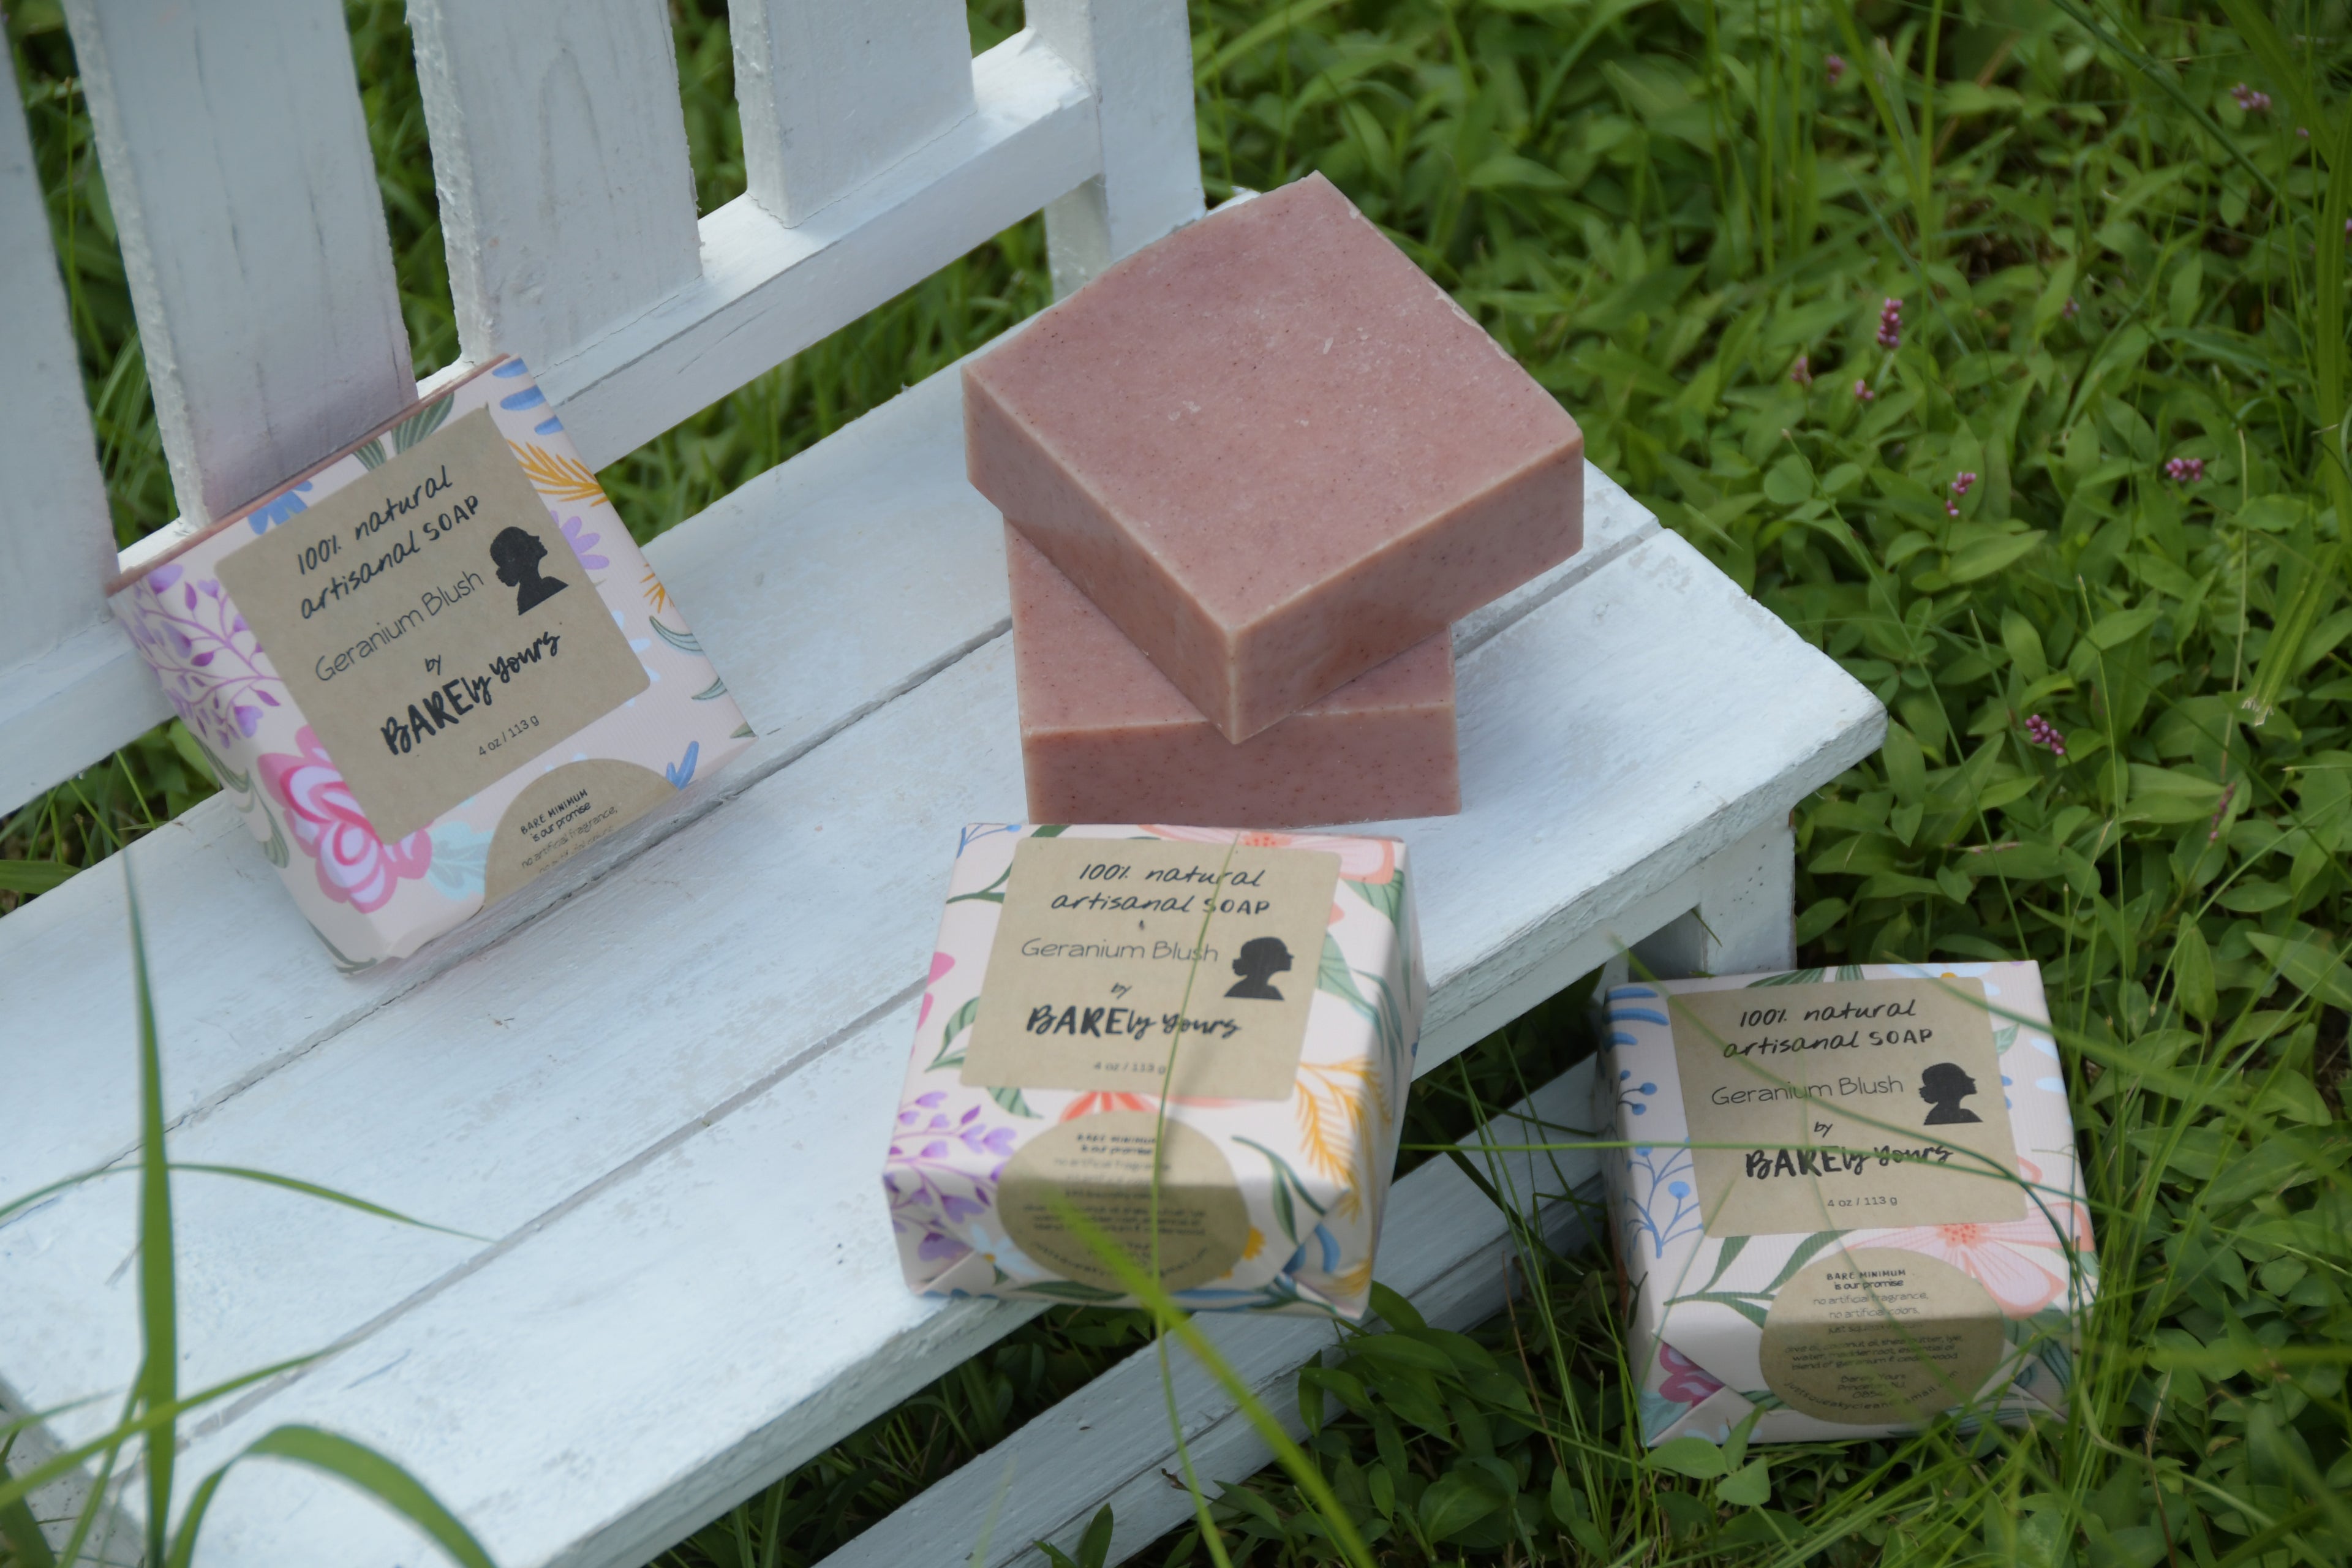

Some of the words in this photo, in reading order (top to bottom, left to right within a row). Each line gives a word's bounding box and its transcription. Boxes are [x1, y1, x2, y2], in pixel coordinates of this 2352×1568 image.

[298, 535, 341, 575] 100%
[355, 465, 453, 540] natural
[301, 530, 420, 619] artisanal
[423, 496, 479, 541] SOAP
[315, 609, 424, 681] Geranium
[421, 571, 484, 616] Blush
[425, 655, 441, 676] by
[380, 676, 492, 755] BAREly
[478, 745, 486, 756] 4
[488, 737, 502, 750] oz
[508, 720, 530, 739] 113
[530, 715, 540, 726] g
[521, 813, 546, 835] BARE
[548, 788, 588, 818] MINIMUM
[530, 833, 540, 842] is
[540, 823, 554, 838] our
[556, 802, 592, 829] promise
[521, 858, 533, 869] no
[569, 806, 618, 839] fragrance,
[1079, 864, 1132, 881] 100%
[1145, 865, 1266, 888] natural
[1050, 891, 1196, 913] artisanal
[1202, 898, 1271, 915] SOAP
[1021, 938, 1145, 959] Geranium
[1152, 940, 1219, 962] Blush
[1110, 982, 1133, 1000] by
[1026, 1004, 1156, 1041] BAREly
[1740, 1008, 1787, 1027] 100%
[1804, 999, 1917, 1021] natural
[1723, 1031, 1860, 1058] artisanal
[1869, 1028, 1933, 1046] SOAP
[1712, 1080, 1833, 1106] Geranium
[1839, 1075, 1904, 1096] Blush
[1814, 1121, 1833, 1138] by
[1827, 1199, 1835, 1207] 4
[1839, 1199, 1853, 1207] oz
[1865, 1196, 1887, 1205] 113
[1890, 1196, 1898, 1206] g
[1826, 1272, 1855, 1281] BARE
[1860, 1268, 1907, 1279] MINIMUM
[1834, 1281, 1842, 1291] is
[1863, 1278, 1904, 1291] promise
